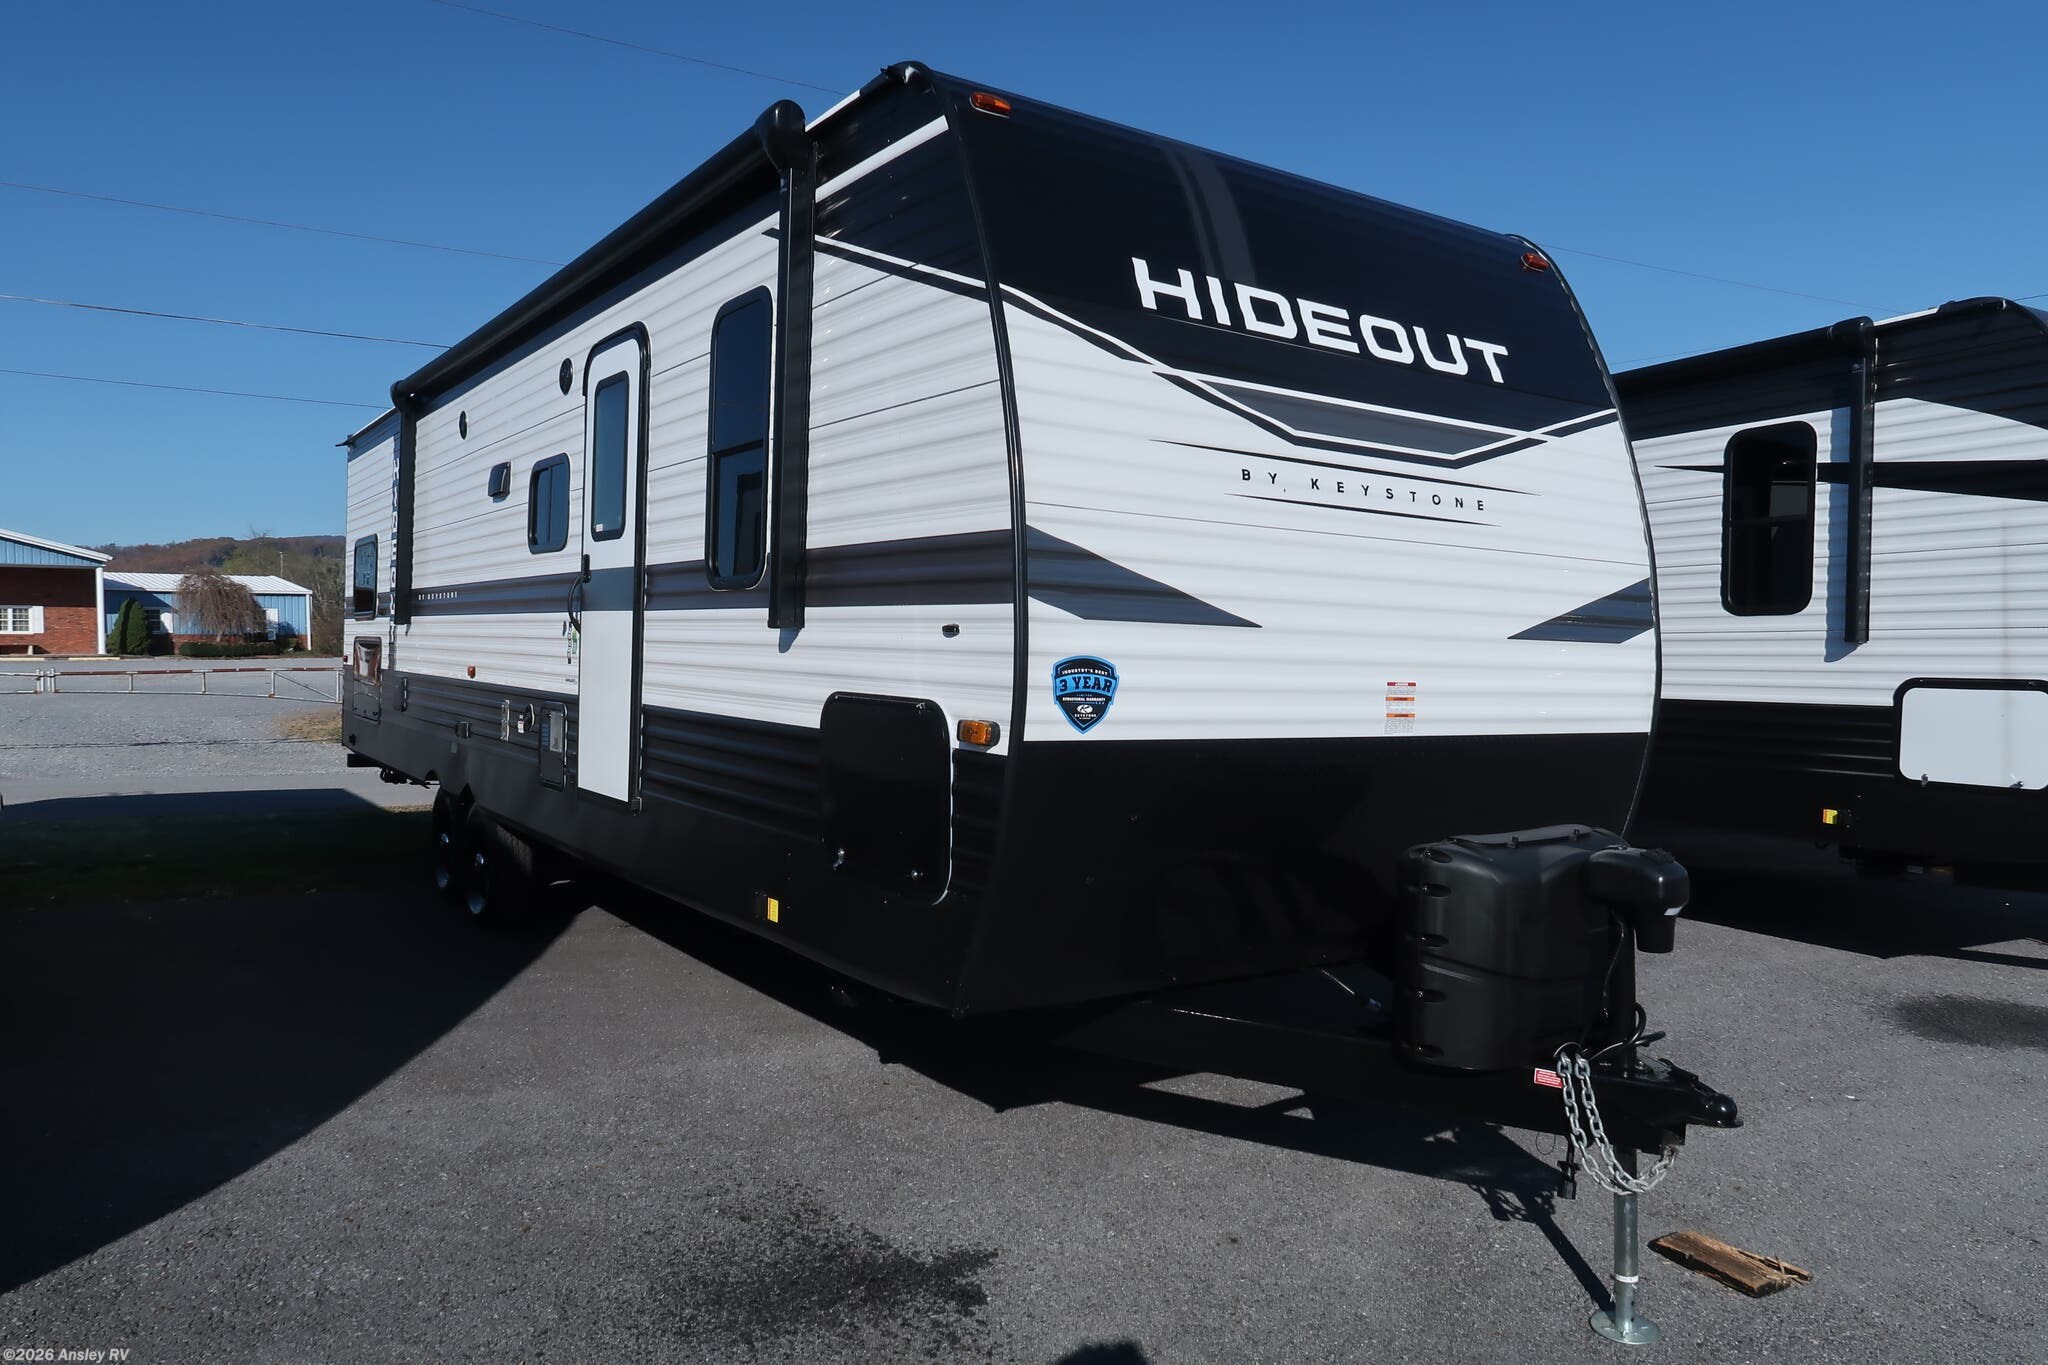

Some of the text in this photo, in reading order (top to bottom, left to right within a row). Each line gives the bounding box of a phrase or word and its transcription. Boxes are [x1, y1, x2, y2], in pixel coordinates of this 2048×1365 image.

[1131, 257, 1508, 383] HIDEOUT
[1311, 477, 1485, 511] KEYSTONE
[1059, 676, 1113, 693] 3 YEAR
